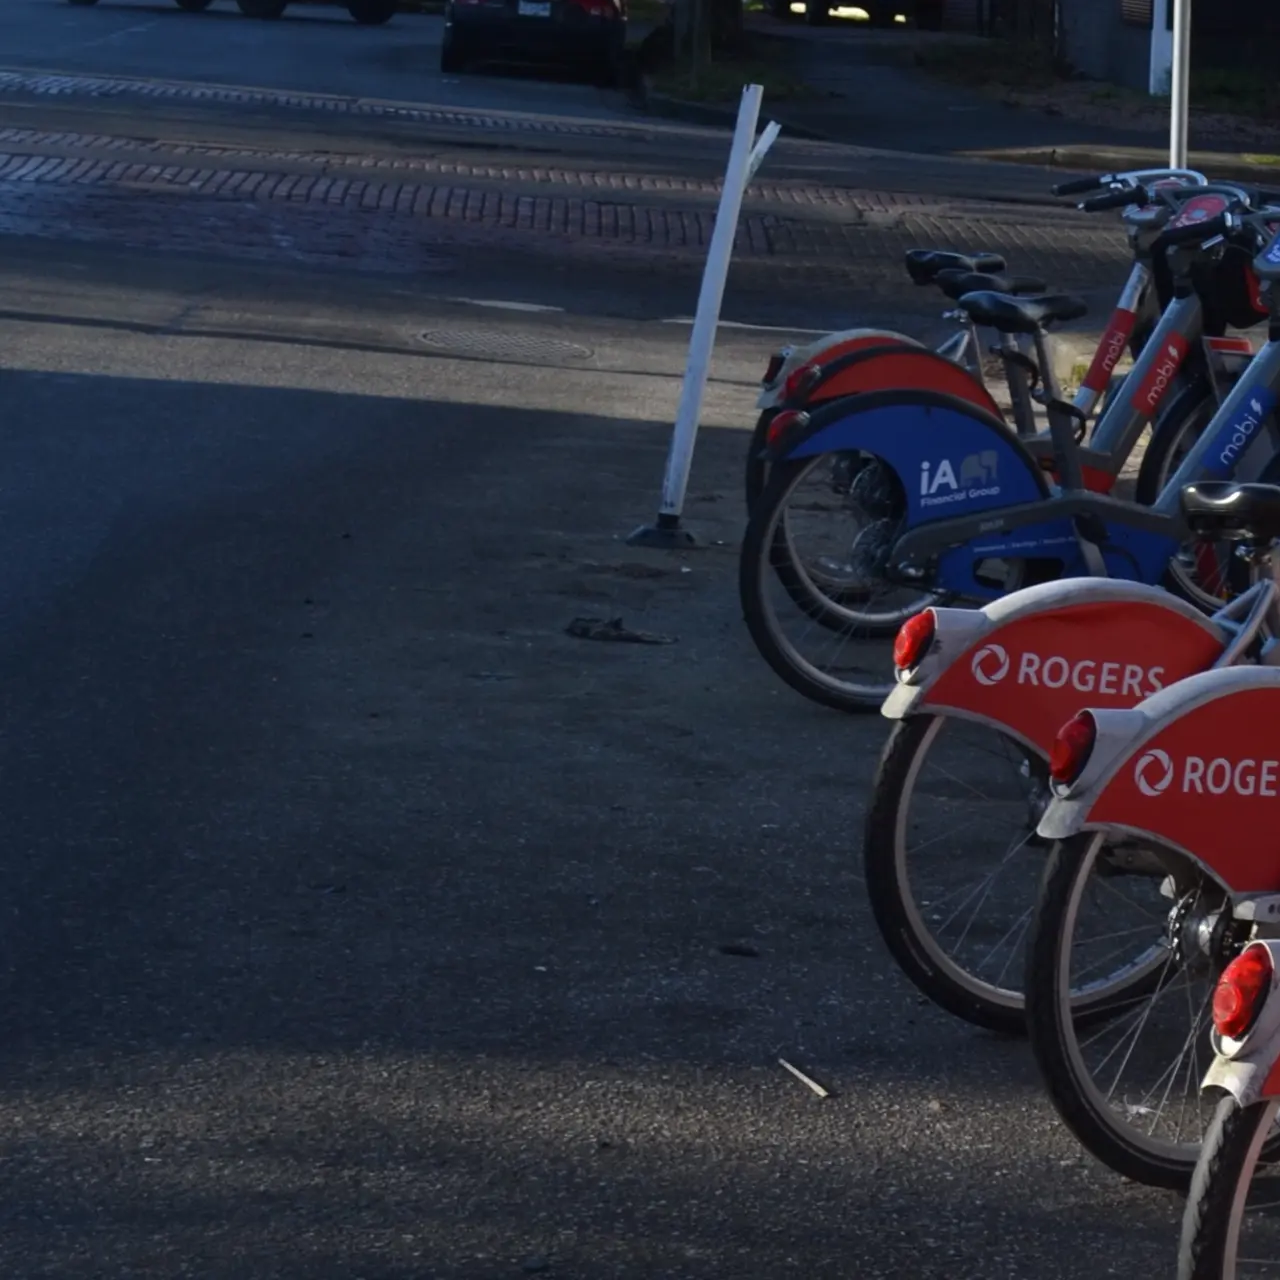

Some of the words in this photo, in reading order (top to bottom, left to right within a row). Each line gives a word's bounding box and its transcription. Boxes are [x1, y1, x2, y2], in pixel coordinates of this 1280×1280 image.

[1103, 332, 1126, 371] mobi
[1147, 359, 1176, 406] mobi
[1219, 413, 1258, 466] mobi
[920, 459, 958, 496] iA
[920, 490, 967, 508] Financial
[968, 486, 1000, 498] Group
[1019, 653, 1165, 698] ROGERS
